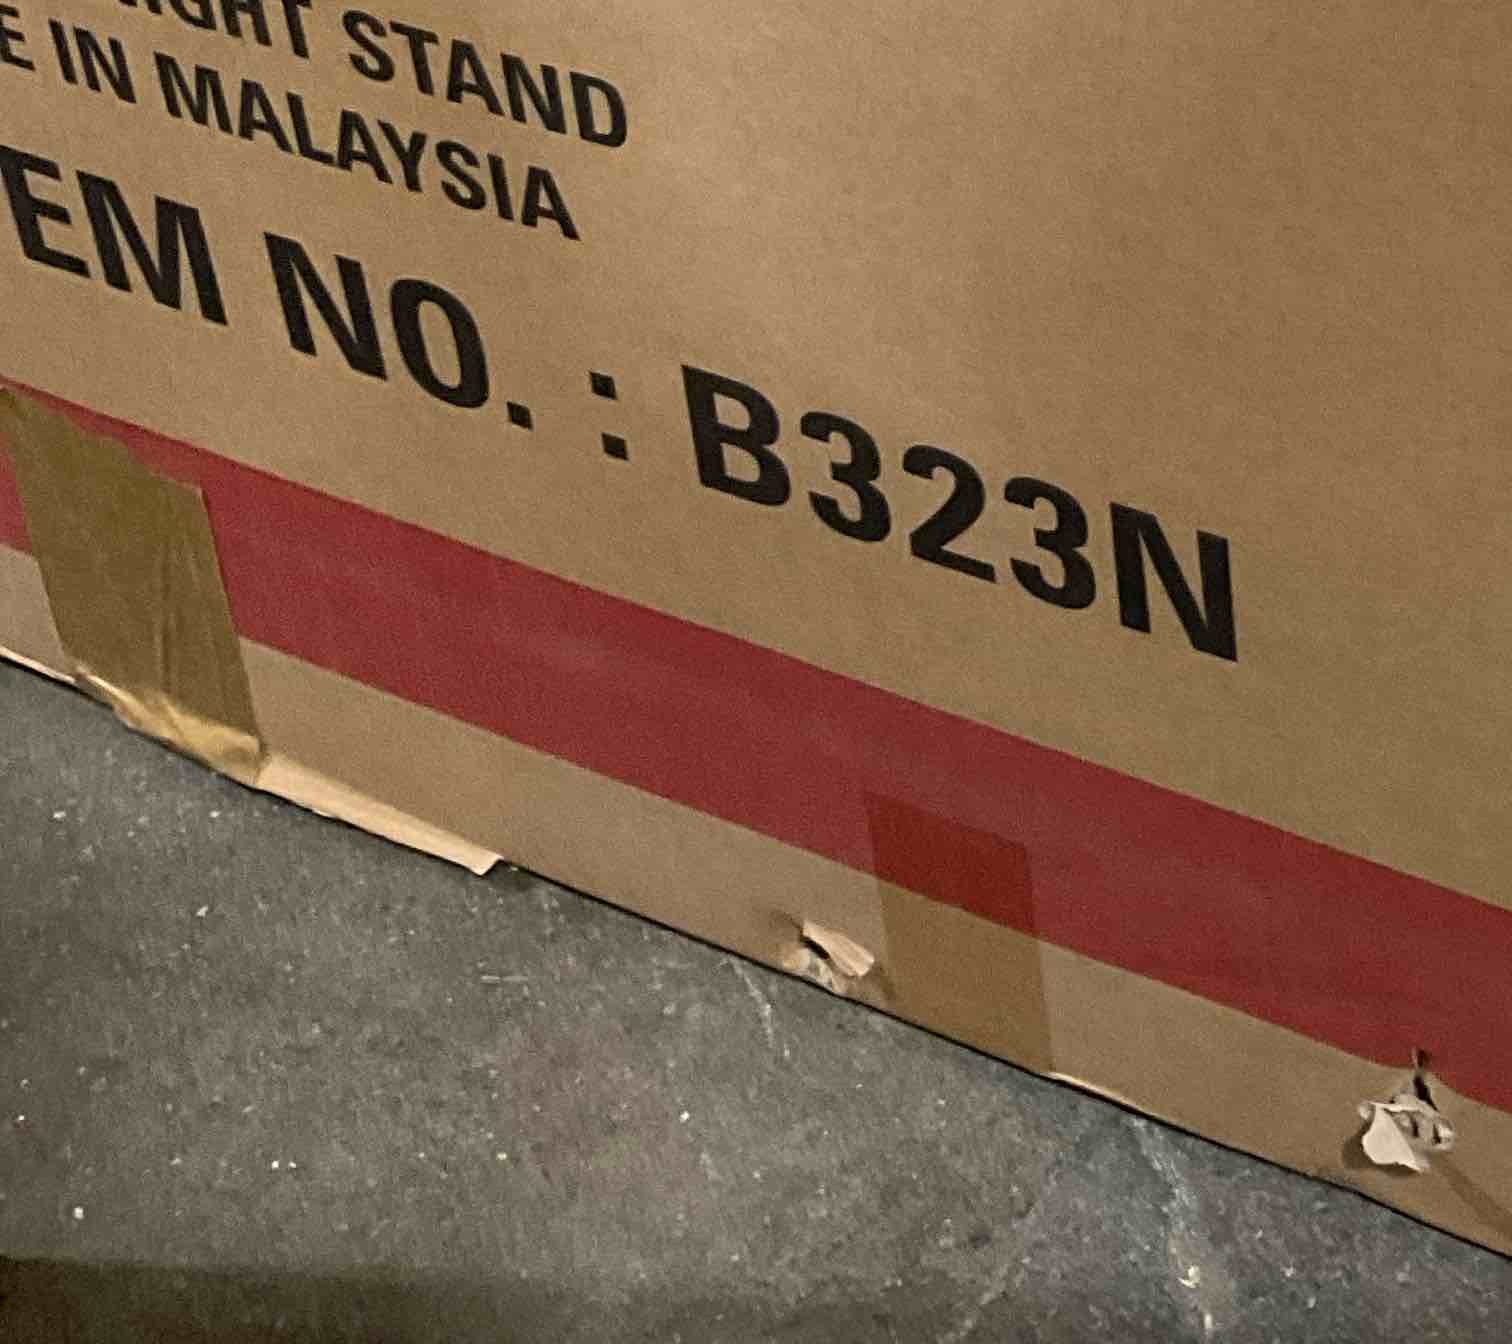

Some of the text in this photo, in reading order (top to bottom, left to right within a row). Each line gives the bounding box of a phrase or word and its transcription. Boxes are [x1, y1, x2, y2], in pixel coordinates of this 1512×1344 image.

[48, 18, 137, 104] IN
[153, 51, 581, 242] MALAYSIA
[342, 10, 628, 148] STAND
[263, 231, 533, 430] NO.
[680, 364, 1238, 663] B323N
